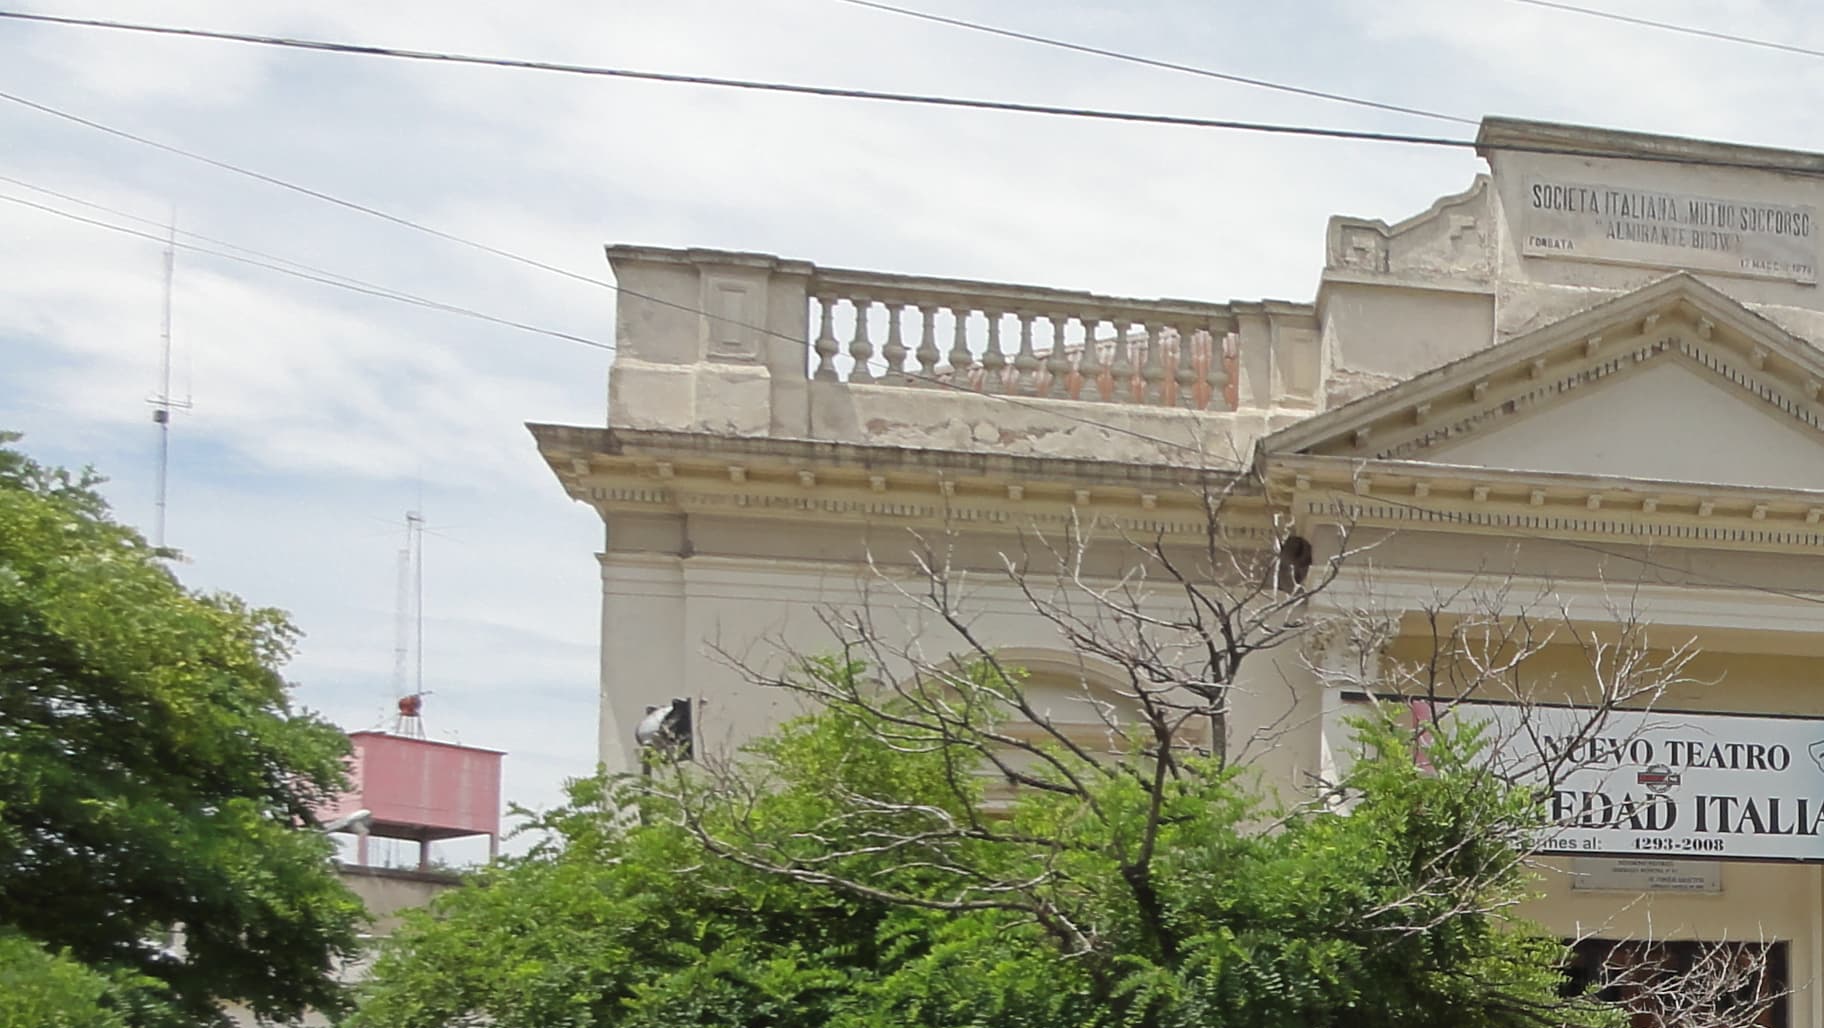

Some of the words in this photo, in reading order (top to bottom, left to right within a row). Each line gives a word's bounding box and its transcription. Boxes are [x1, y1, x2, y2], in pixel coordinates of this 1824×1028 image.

[1740, 206, 1810, 237] SOCCORSO
[1544, 735, 1654, 766] NUEVO
[1664, 740, 1790, 771] TEATRO
[1583, 836, 1602, 851] al:
